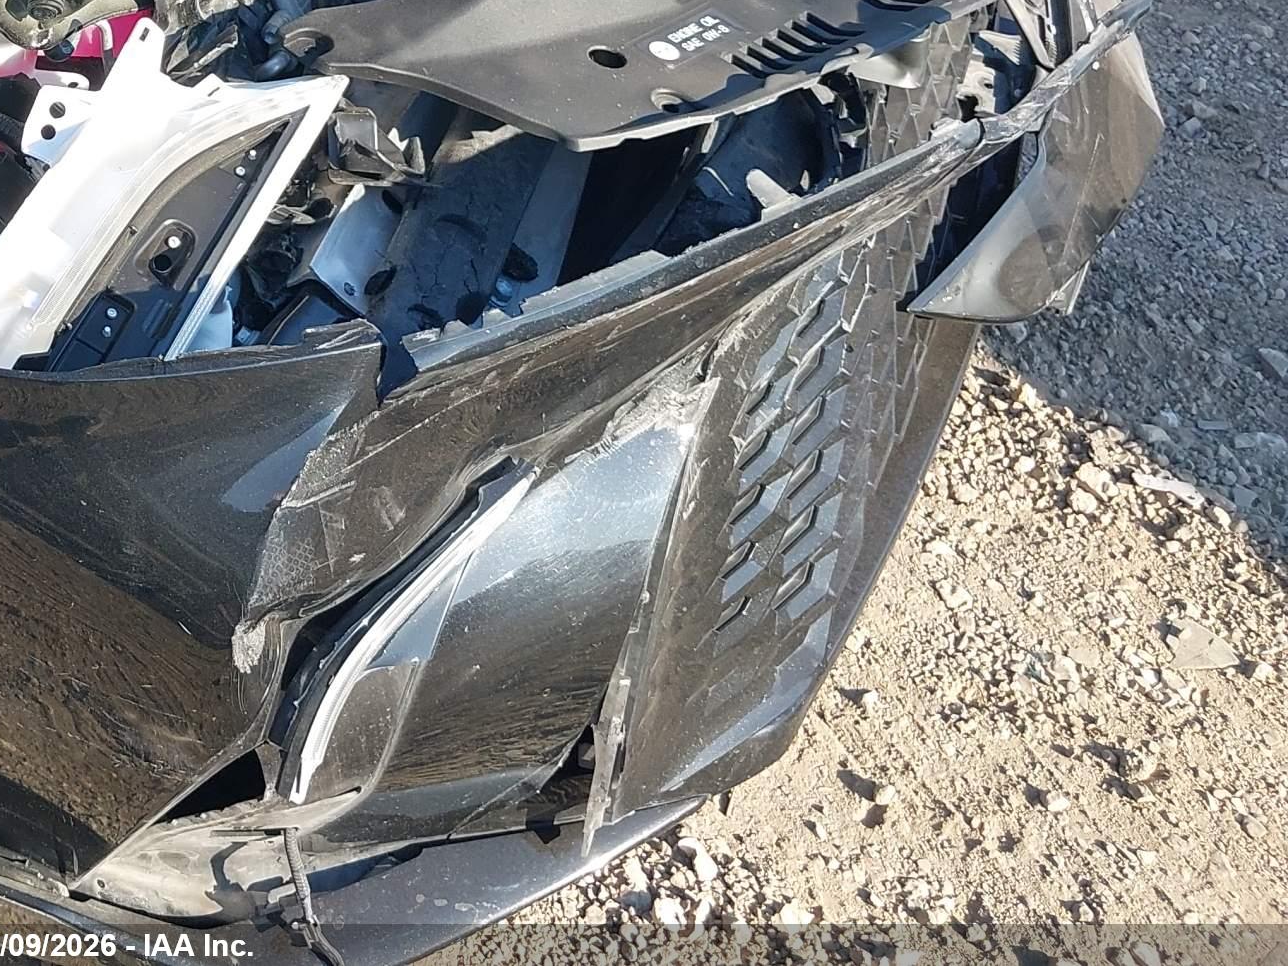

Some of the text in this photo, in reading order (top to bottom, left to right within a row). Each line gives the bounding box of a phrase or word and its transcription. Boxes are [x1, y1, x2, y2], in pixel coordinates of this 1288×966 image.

[667, 15, 721, 43] ENGINE OIL
[682, 37, 704, 51] SAE
